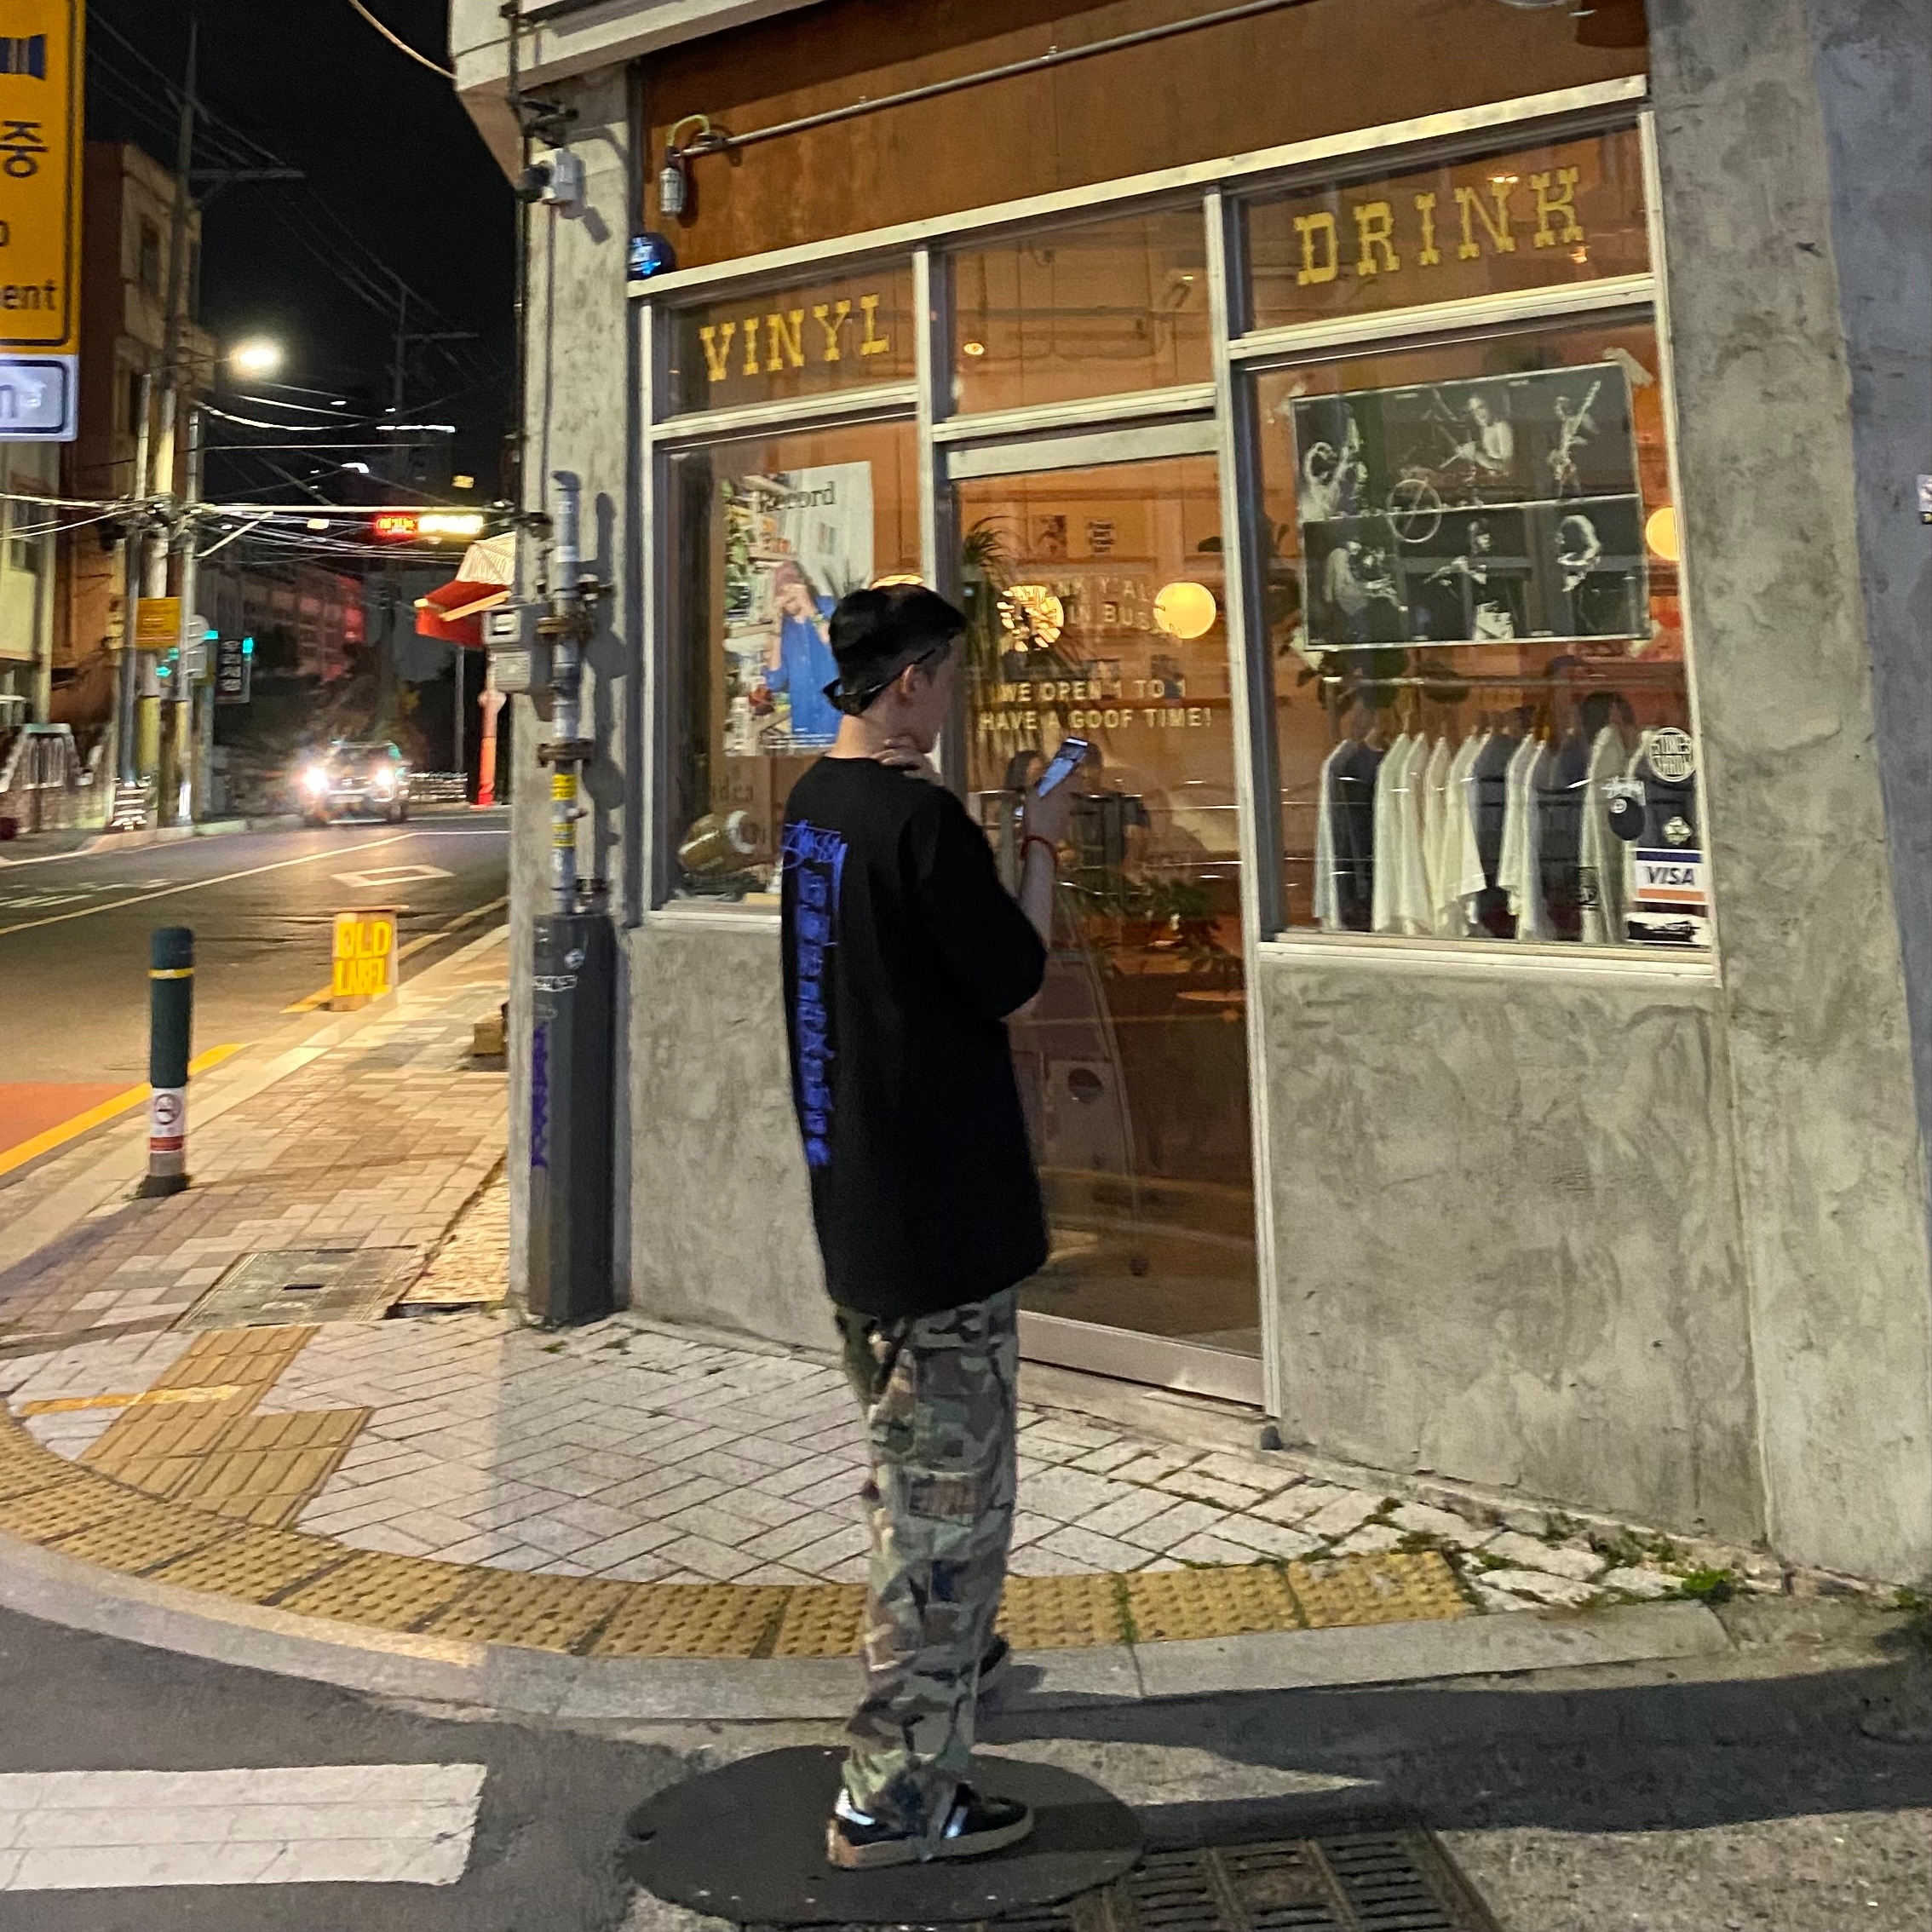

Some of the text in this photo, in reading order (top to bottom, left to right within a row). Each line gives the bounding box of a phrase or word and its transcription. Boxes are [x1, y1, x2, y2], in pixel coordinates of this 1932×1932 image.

[1293, 166, 1584, 286] DRINK
[699, 294, 889, 382] VINYL
[980, 710, 1038, 731] HAVE
[1044, 710, 1061, 730] A
[1143, 706, 1211, 727] TIME!
[1646, 865, 1695, 886] VISA
[338, 921, 393, 959] OLD
